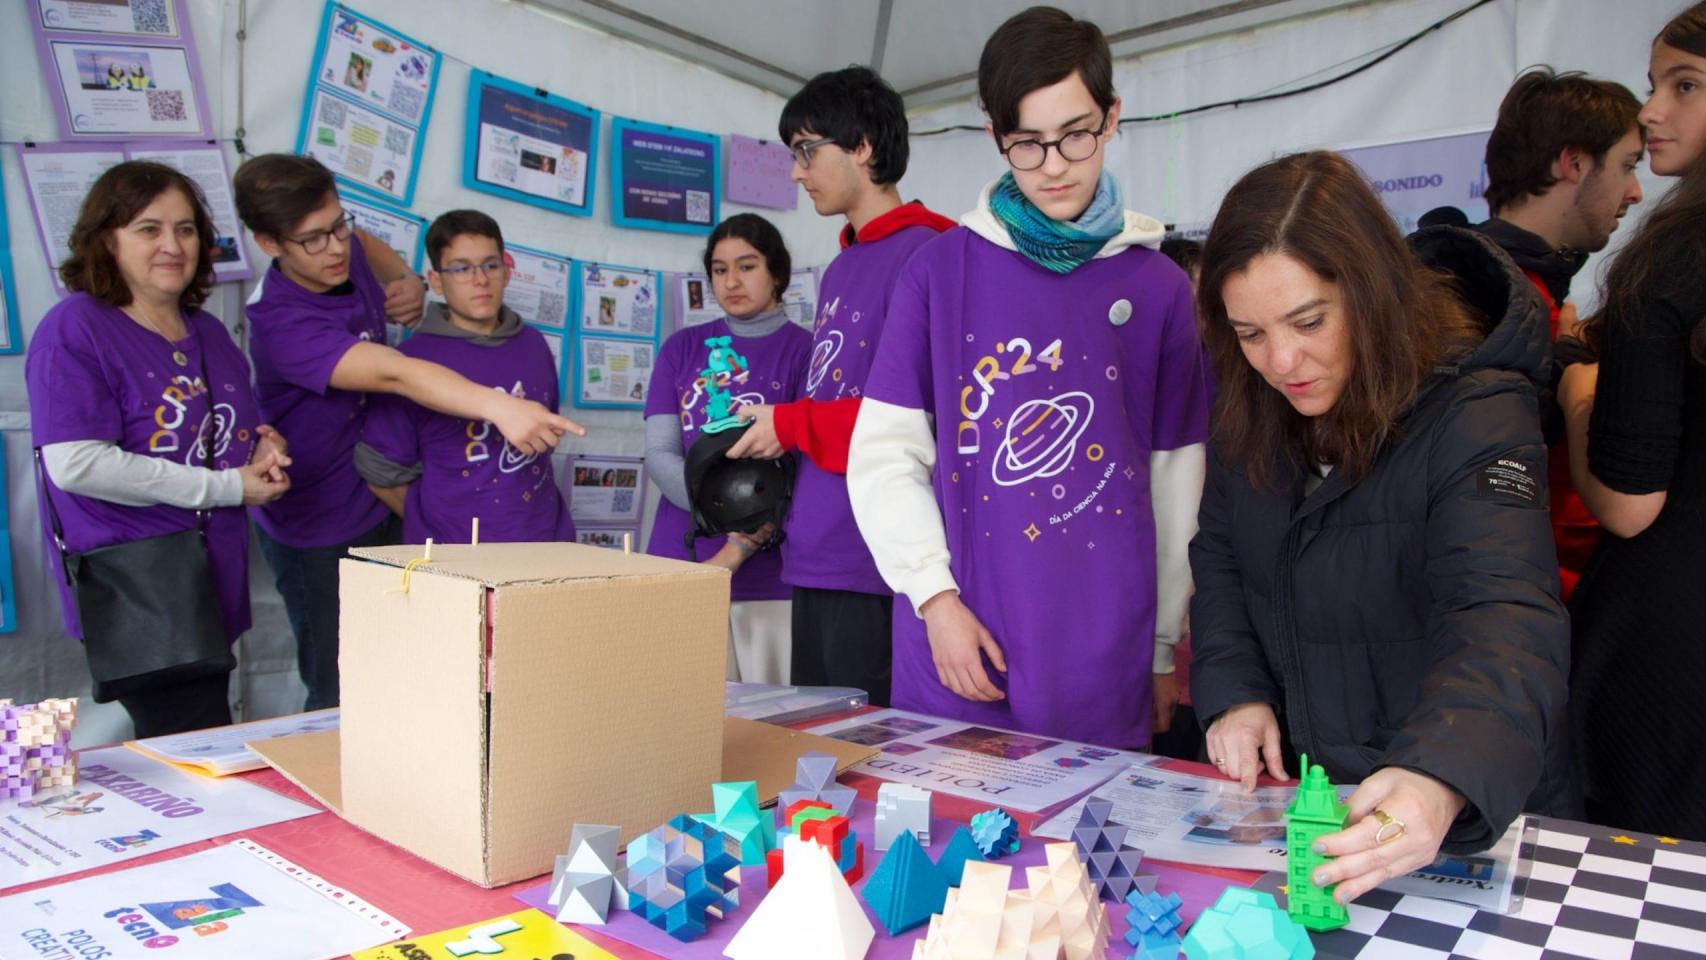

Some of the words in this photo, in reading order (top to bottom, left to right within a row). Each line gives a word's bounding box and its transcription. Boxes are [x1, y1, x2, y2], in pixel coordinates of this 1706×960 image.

[957, 338, 1064, 454] DCR'24
[1049, 514, 1062, 525] DÍA
[1062, 511, 1073, 521] DA
[1073, 491, 1099, 514] CIENCIA
[1096, 479, 1107, 491] NA
[79, 764, 204, 818] PAXARIÑO
[60, 929, 112, 960] POLOS
[103, 907, 180, 949] tecno
